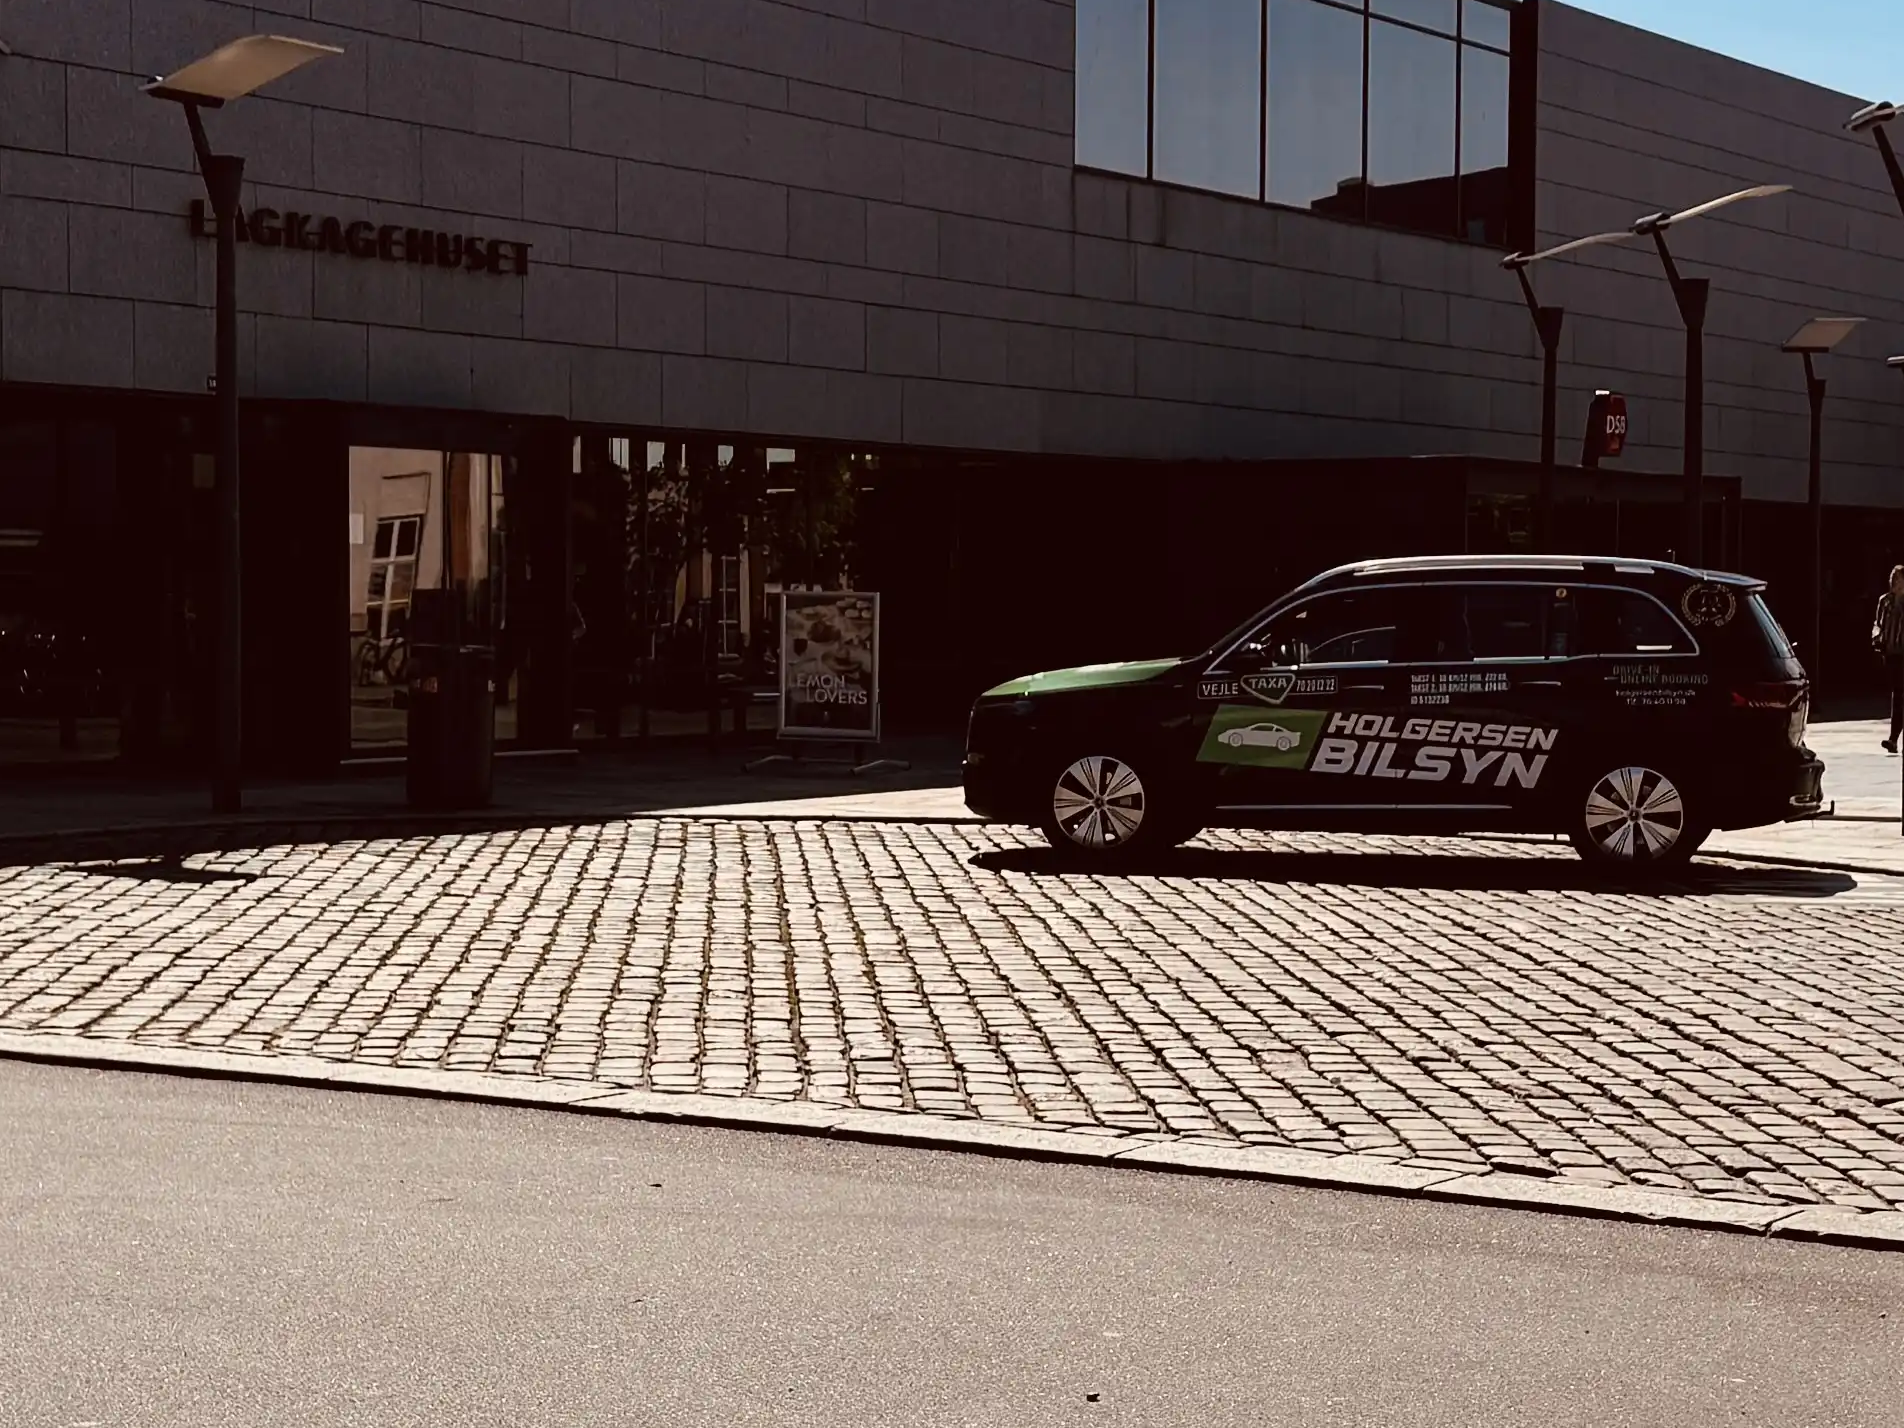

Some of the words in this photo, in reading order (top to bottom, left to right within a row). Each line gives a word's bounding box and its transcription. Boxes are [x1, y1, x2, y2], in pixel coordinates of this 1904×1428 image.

[1606, 415, 1626, 434] DSB
[788, 673, 845, 689] LEMON
[1202, 683, 1239, 696] VEJLE
[1248, 676, 1288, 689] TAXA
[806, 688, 868, 705] LOVERS
[1327, 711, 1559, 751] HOLGERSEN
[1309, 737, 1549, 789] BILSYN
